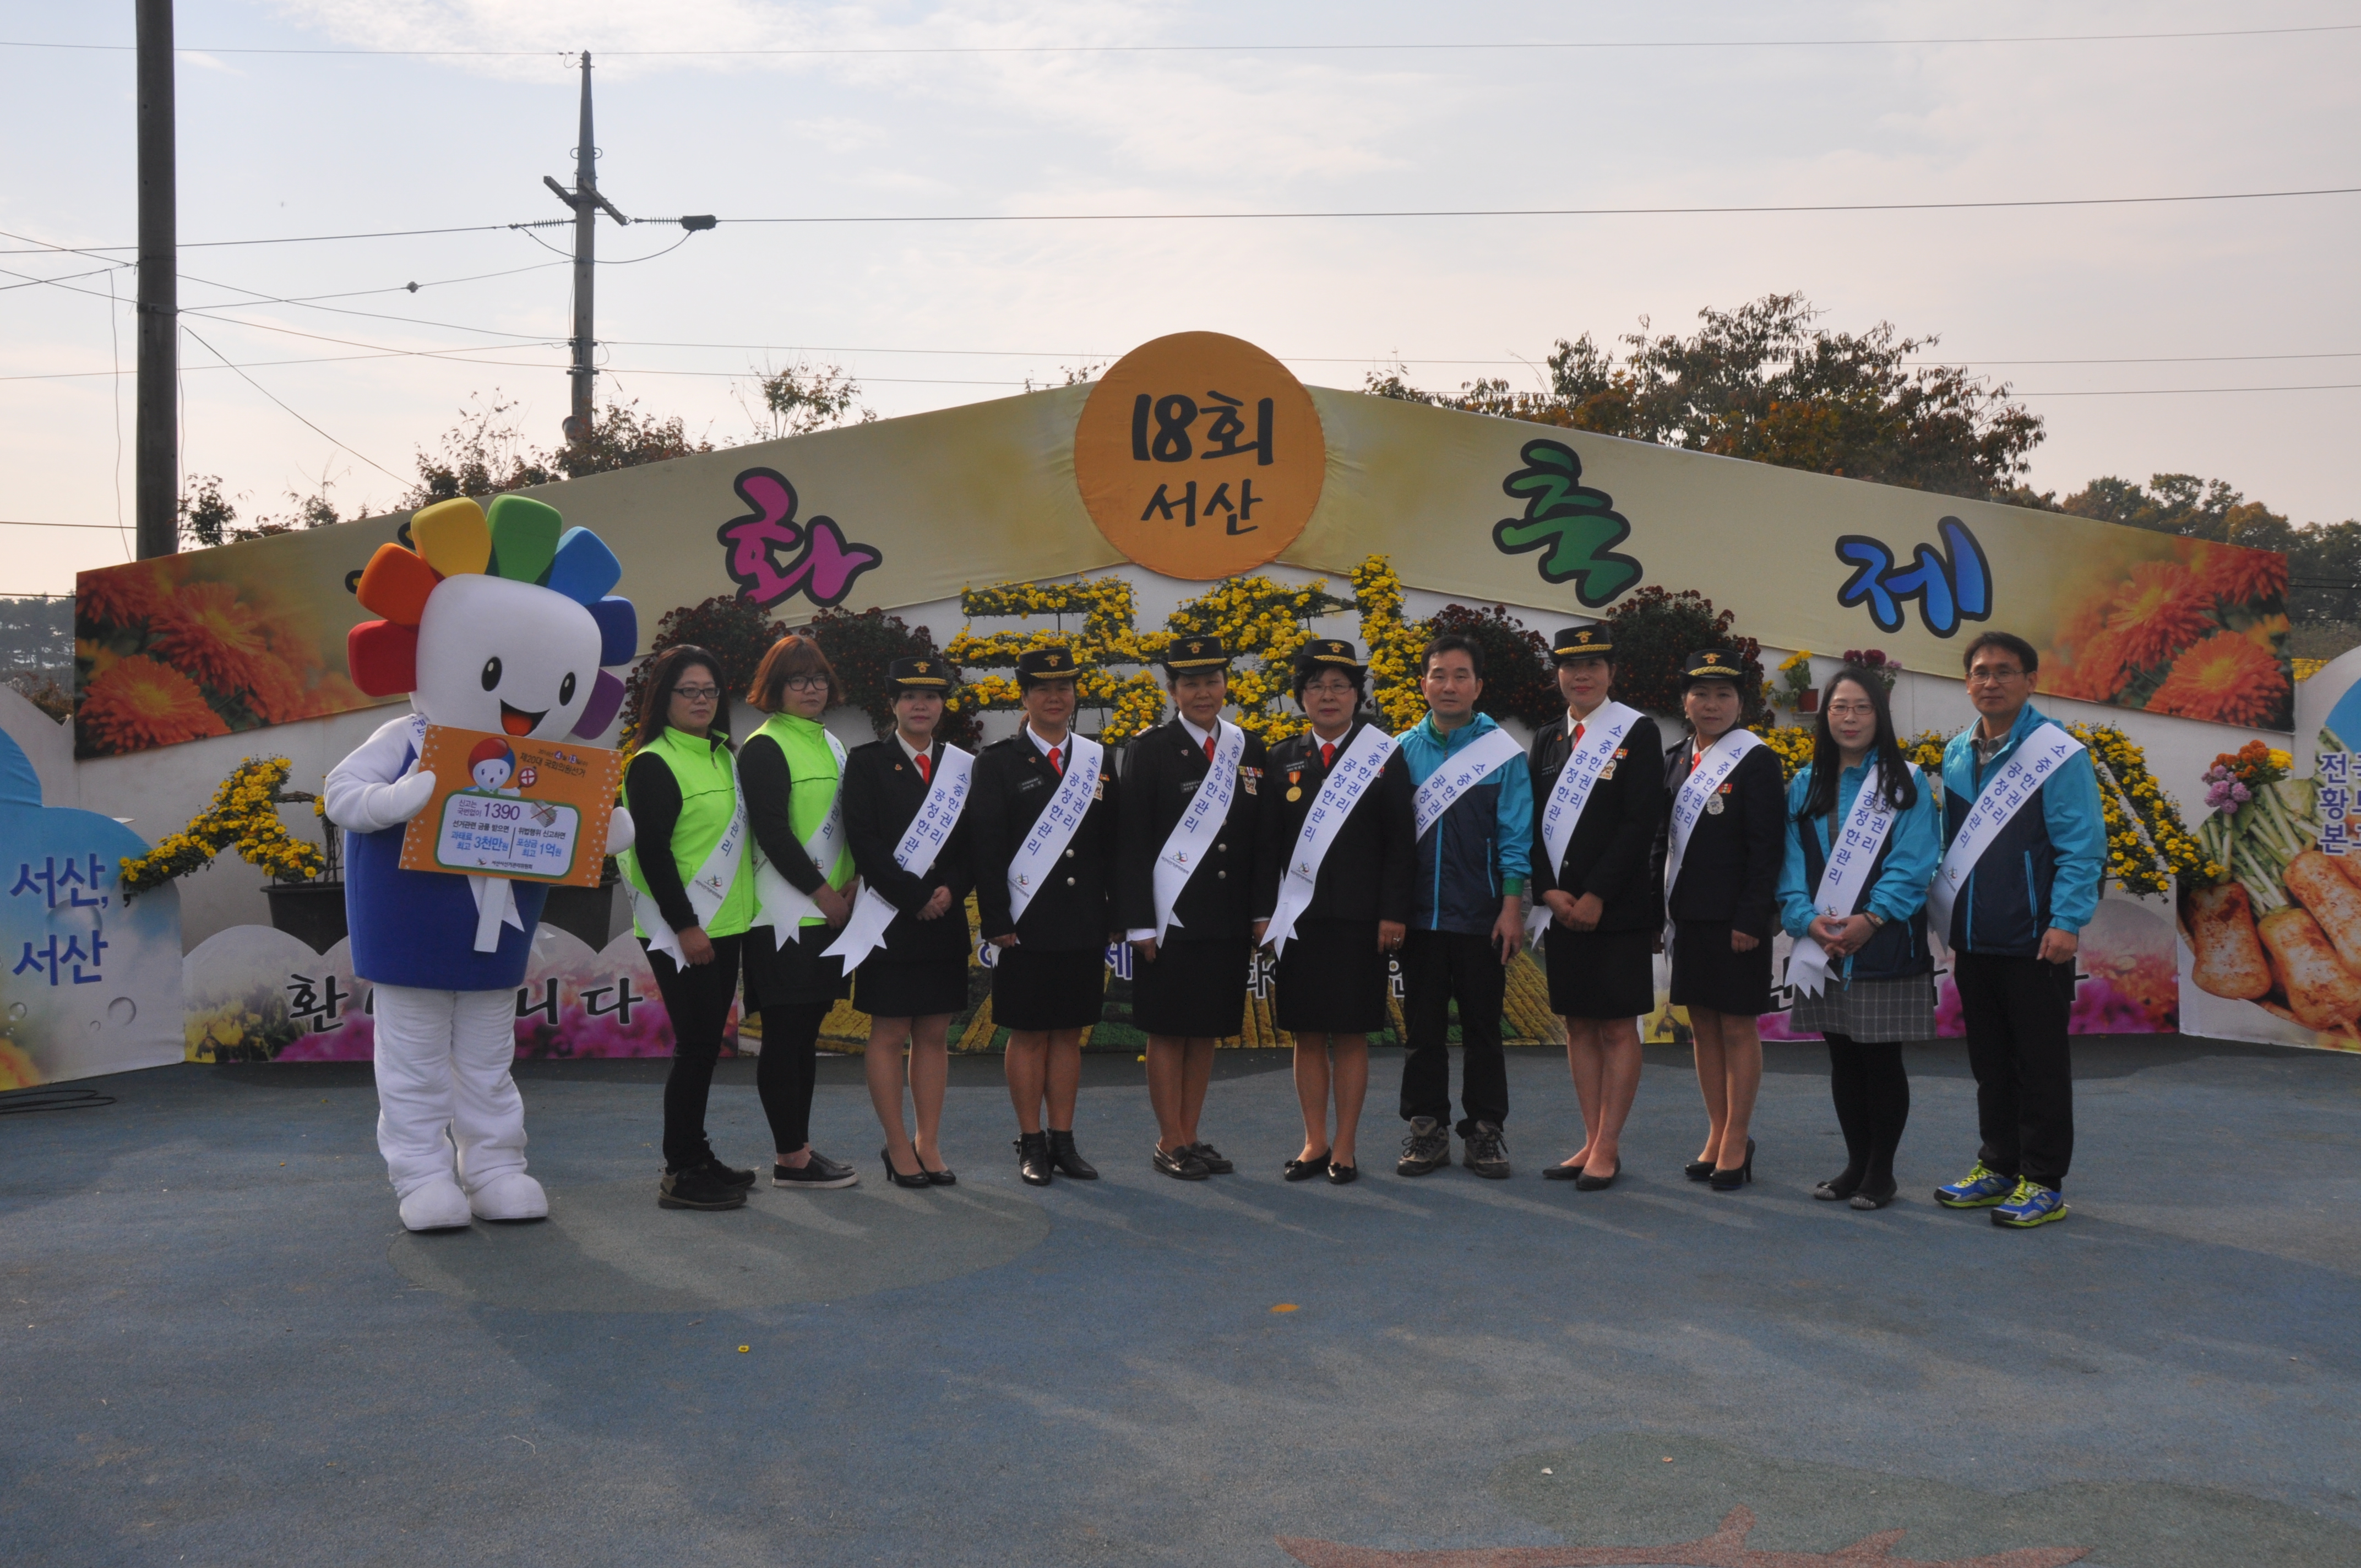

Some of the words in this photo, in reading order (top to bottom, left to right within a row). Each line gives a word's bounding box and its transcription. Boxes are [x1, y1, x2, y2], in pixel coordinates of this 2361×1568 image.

[1132, 390, 1274, 466] 18회
[1141, 479, 1263, 536] 서산
[459, 799, 477, 808] 신고는
[458, 808, 482, 817] 국번없이
[485, 802, 520, 820] 1390
[453, 820, 477, 830] 선거관련
[478, 822, 490, 831] 금품
[492, 824, 510, 833] 받으면
[543, 830, 566, 840] 신고하면
[474, 836, 509, 851] 3천만원
[516, 838, 538, 848] 포상금
[540, 843, 562, 857] 1억원
[12, 929, 108, 986] 서산
